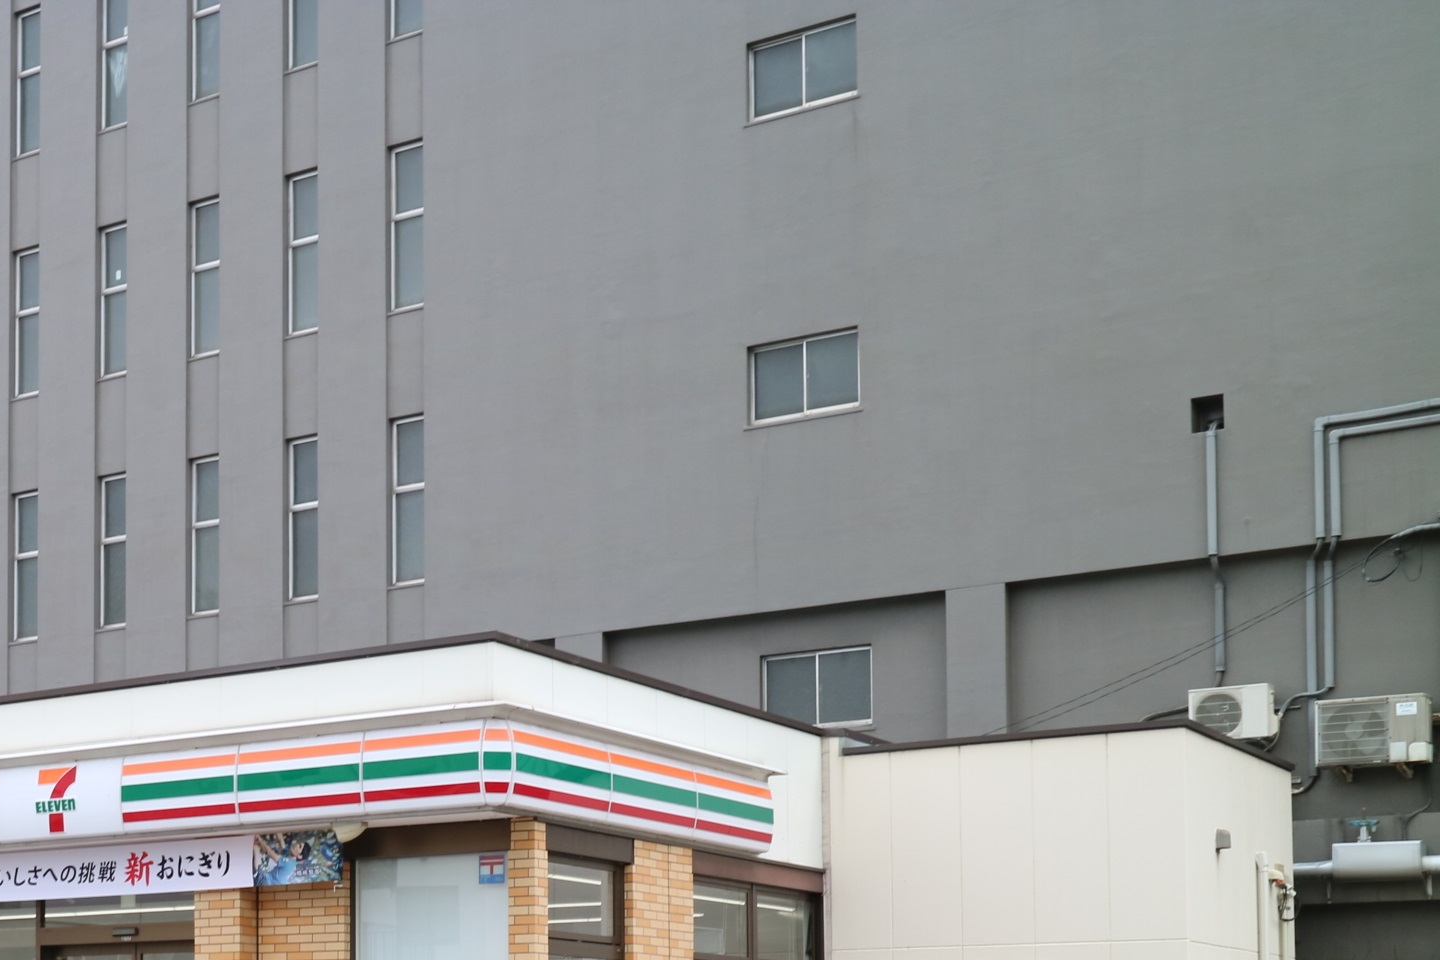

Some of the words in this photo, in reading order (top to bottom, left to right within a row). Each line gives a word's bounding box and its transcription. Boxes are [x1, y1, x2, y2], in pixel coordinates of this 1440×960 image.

[38, 766, 77, 833] 7
[124, 851, 154, 887] 新
[157, 850, 231, 880] おにぎり
